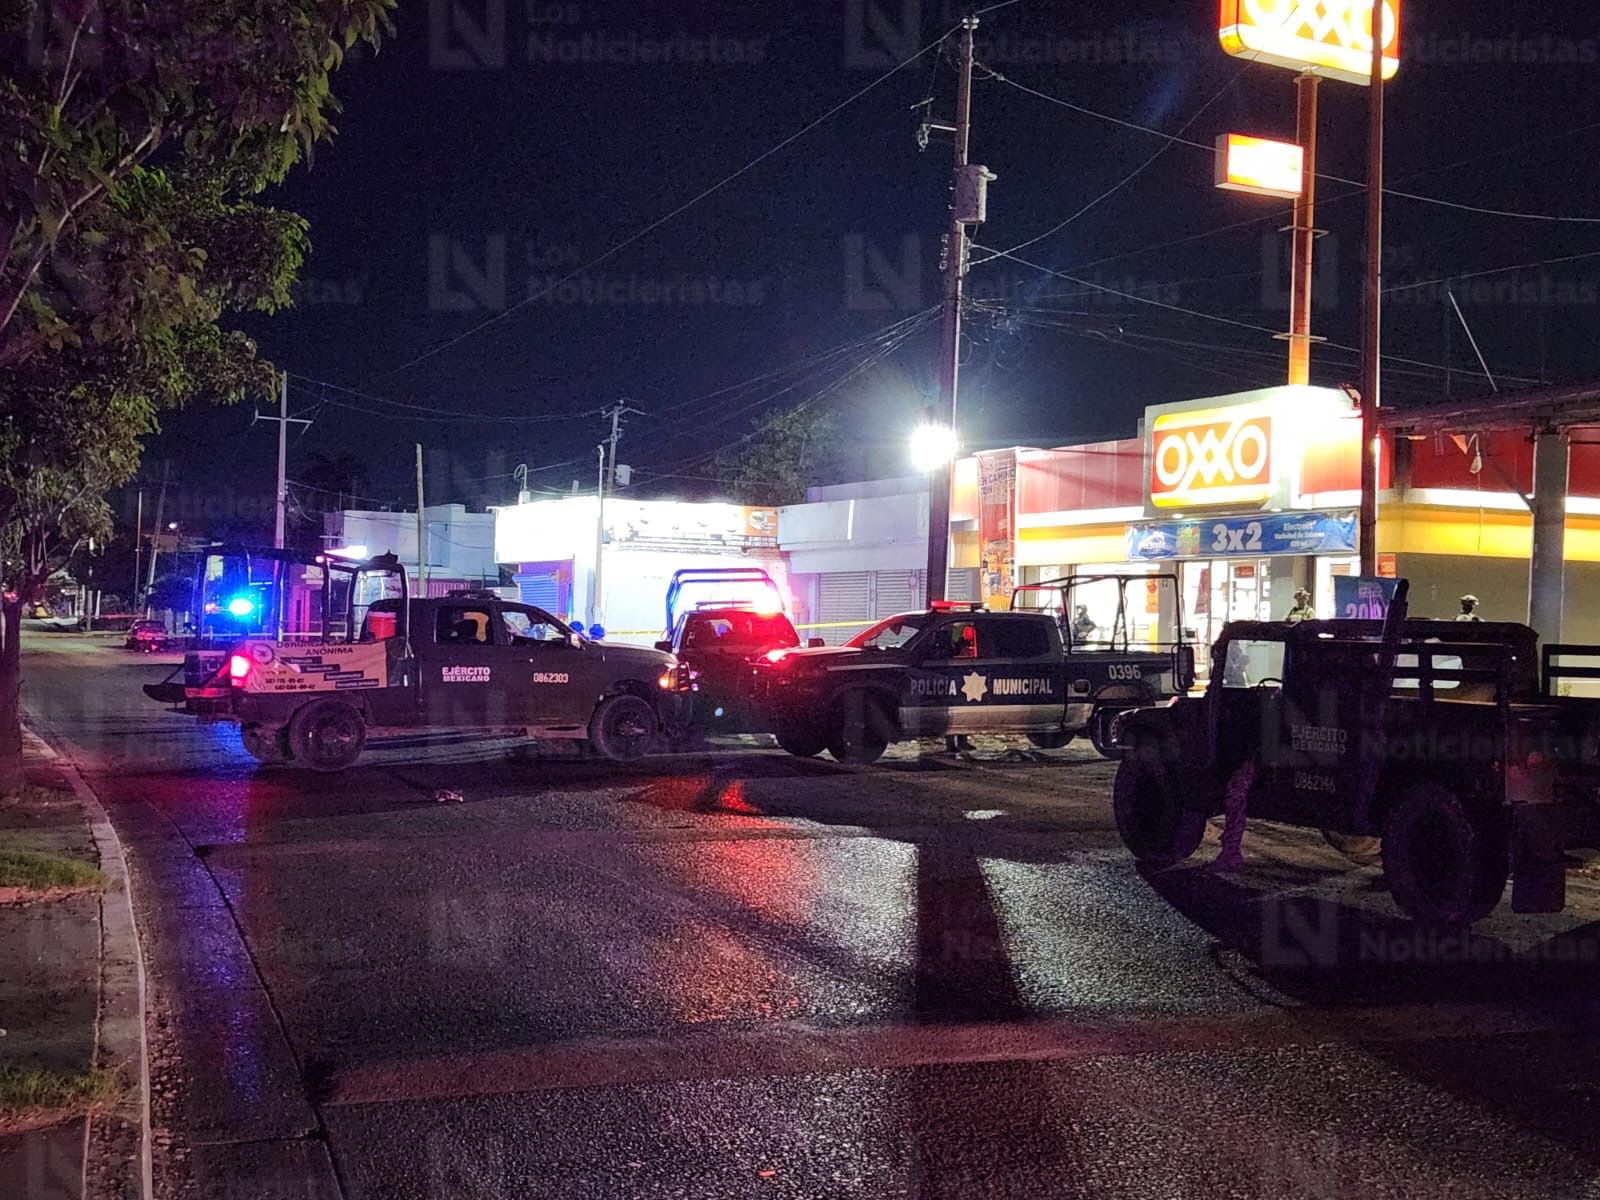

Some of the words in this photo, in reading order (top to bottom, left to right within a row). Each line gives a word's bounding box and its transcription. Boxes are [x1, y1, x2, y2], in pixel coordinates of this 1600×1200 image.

[1155, 422, 1268, 491] OXXO
[1211, 521, 1263, 553] 3x2
[441, 664, 491, 676] EJÉRCITO
[1108, 664, 1142, 680] 0396
[441, 674, 490, 683] MEXICANO
[533, 673, 569, 684] 0862303
[993, 678, 1053, 696] MUNICIPAL
